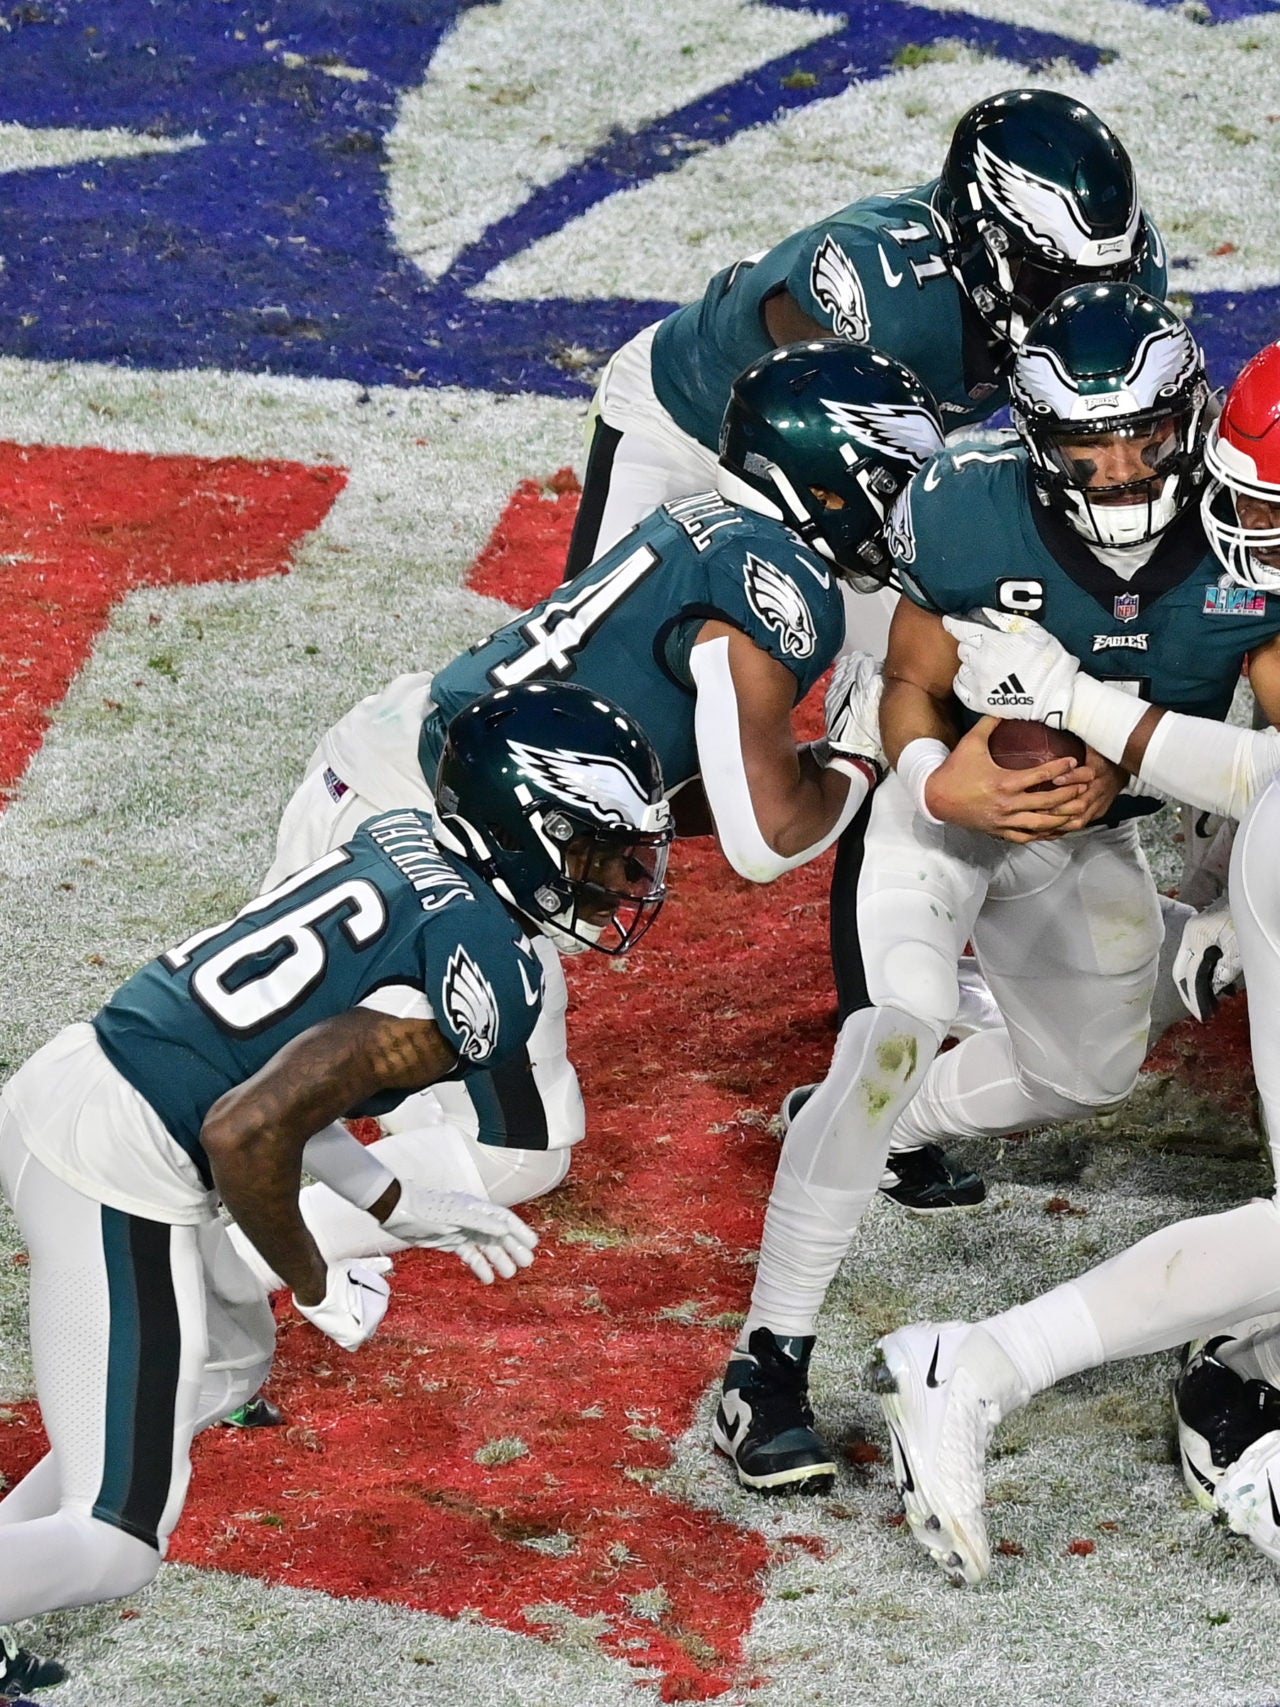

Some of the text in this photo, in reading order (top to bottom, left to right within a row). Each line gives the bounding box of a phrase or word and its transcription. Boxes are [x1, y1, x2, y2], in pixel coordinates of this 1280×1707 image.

[881, 220, 948, 287] 11
[475, 528, 659, 688] 4
[1000, 581, 1043, 611] C
[1118, 606, 1135, 617] NFL
[1092, 633, 1149, 652] EAGLES
[987, 694, 1034, 706] adidas
[160, 845, 388, 1034] 16
